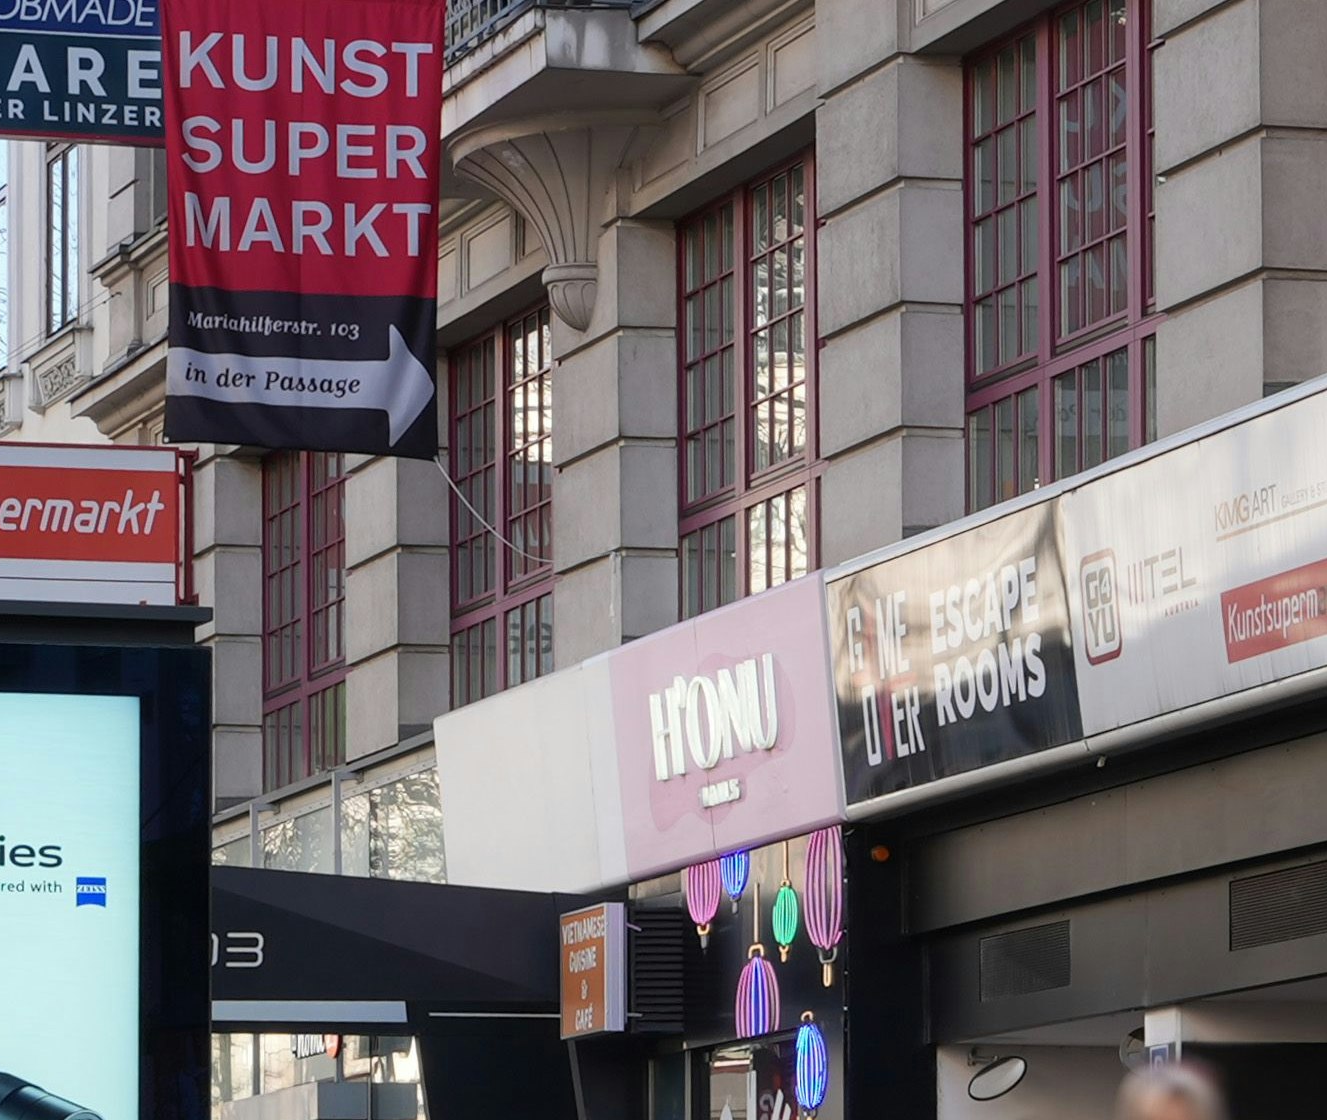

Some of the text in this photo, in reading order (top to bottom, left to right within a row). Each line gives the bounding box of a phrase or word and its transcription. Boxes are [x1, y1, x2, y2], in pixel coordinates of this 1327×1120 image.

[178, 30, 434, 98] KUNST
[43, 101, 162, 127] LINZER
[181, 115, 428, 180] SUPER
[184, 191, 432, 258] MARKT
[187, 311, 360, 341] Mariahilferstr. 103
[185, 362, 361, 399] in der Passage
[929, 556, 1041, 655] ESCAPE
[933, 631, 1047, 727] ROOMS
[30, 880, 63, 894] with
